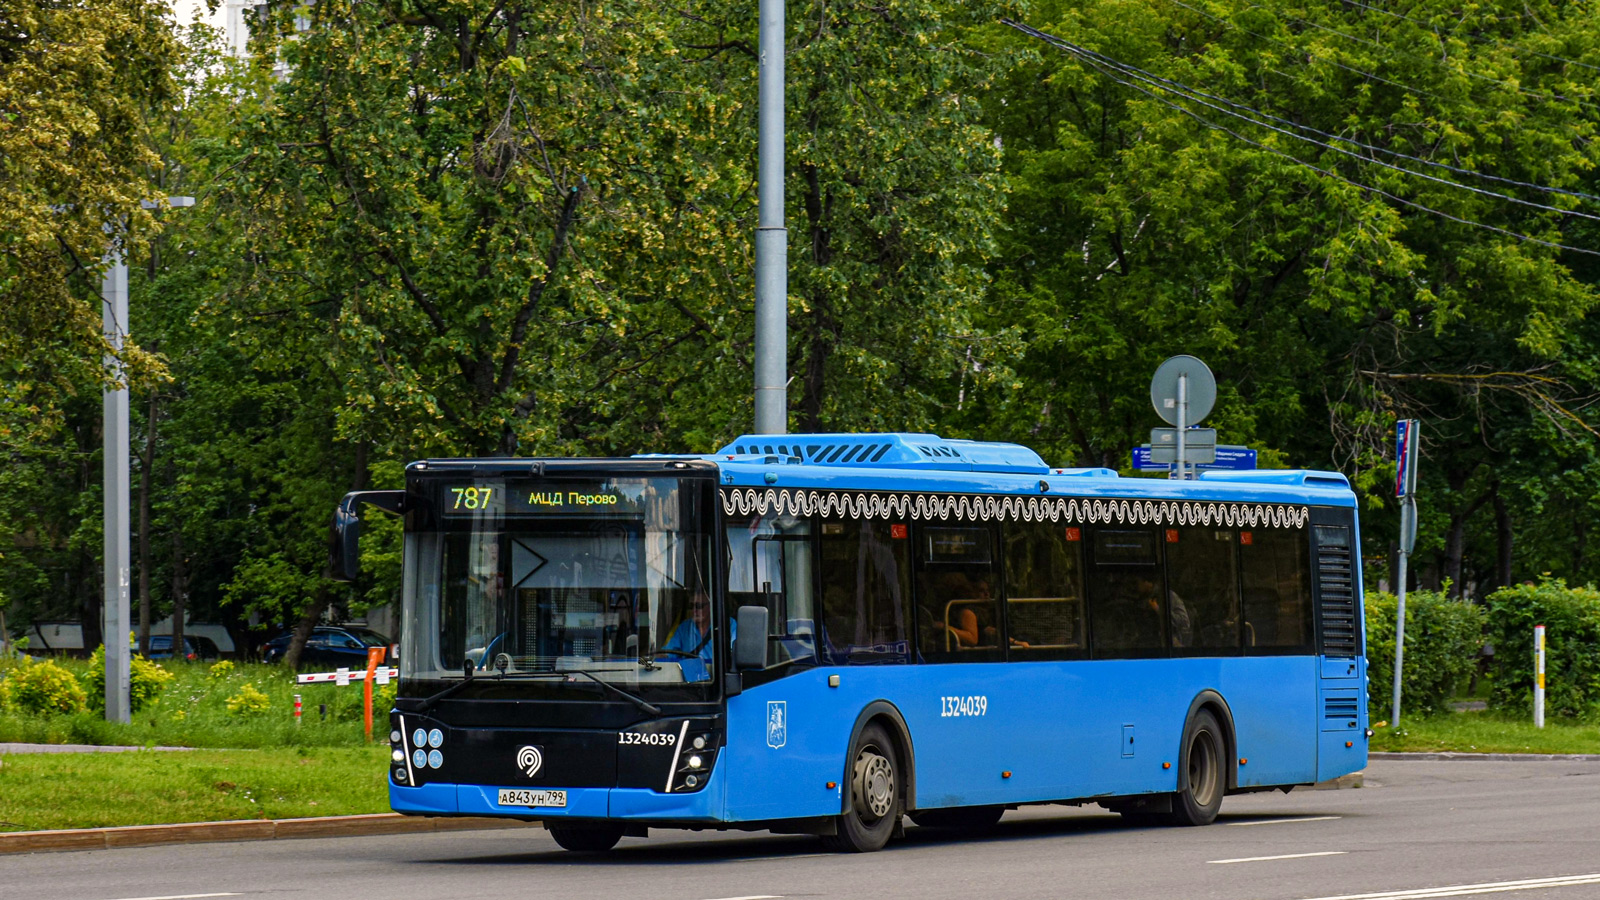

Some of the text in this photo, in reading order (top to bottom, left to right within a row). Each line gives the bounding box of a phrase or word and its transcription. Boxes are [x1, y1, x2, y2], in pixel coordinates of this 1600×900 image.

[451, 487, 492, 510] 787
[528, 492, 617, 506] МЦД Перово
[941, 695, 988, 717] 1324039
[618, 732, 676, 746] 1324039
[546, 791, 564, 802] 799
